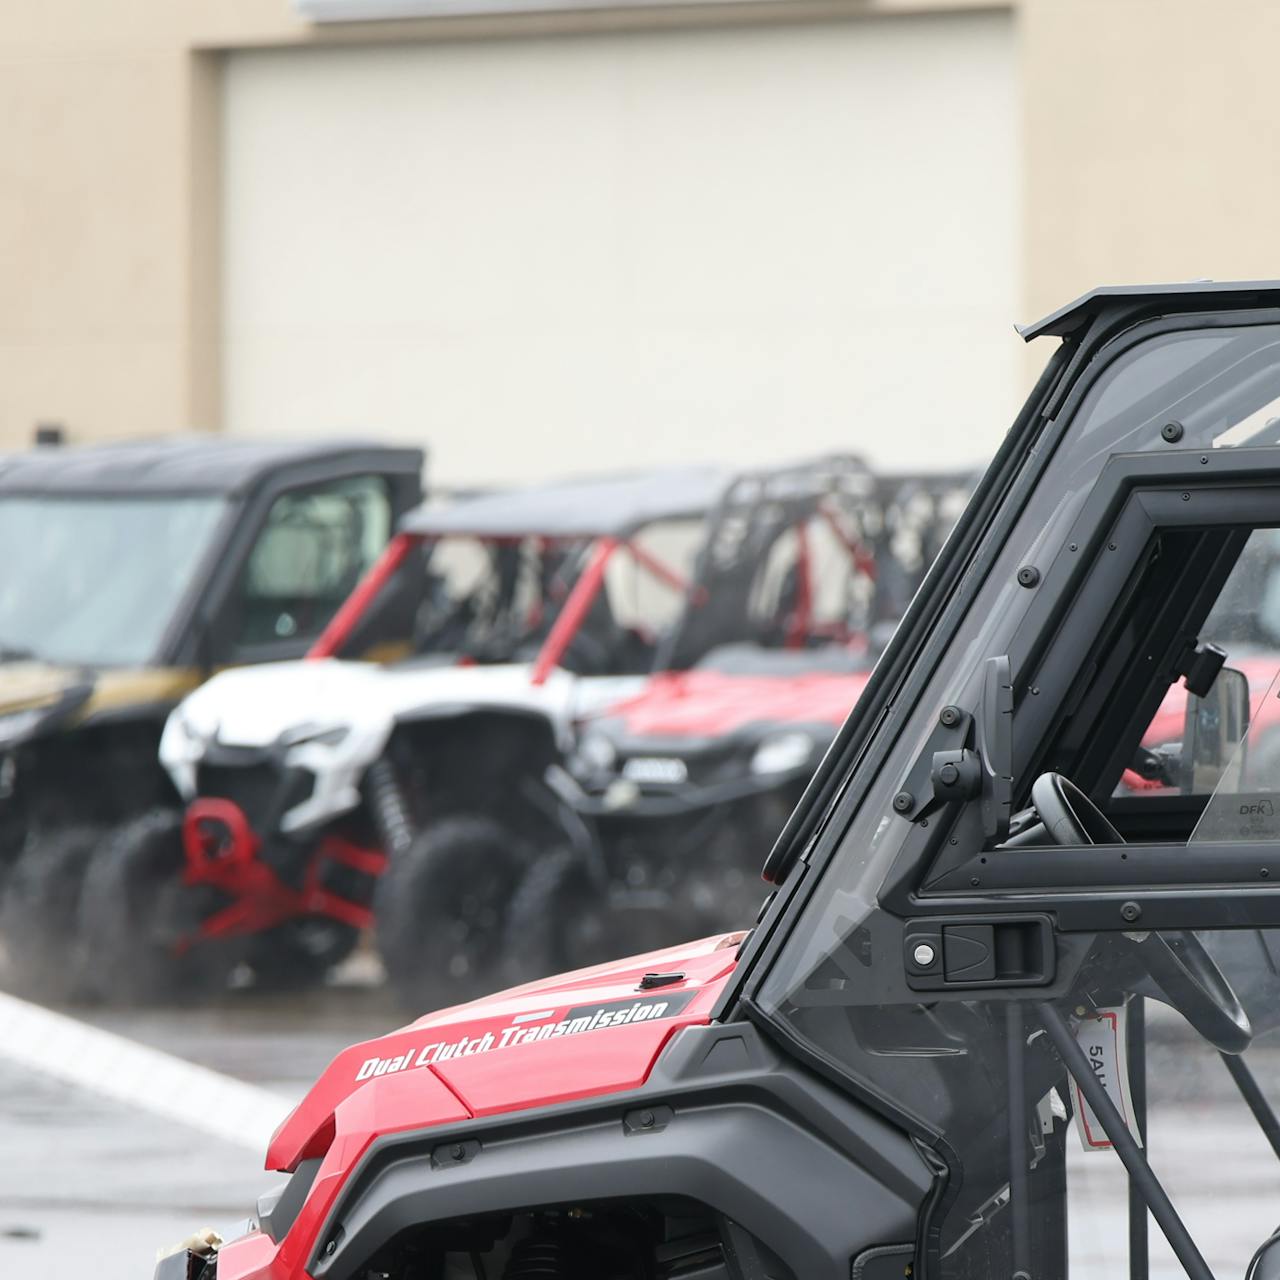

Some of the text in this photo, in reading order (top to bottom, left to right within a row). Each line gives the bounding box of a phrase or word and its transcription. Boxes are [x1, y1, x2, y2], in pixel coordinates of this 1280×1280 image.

[1239, 805, 1265, 815] DFK
[354, 1002, 669, 1081] Dual Clutch Transmission
